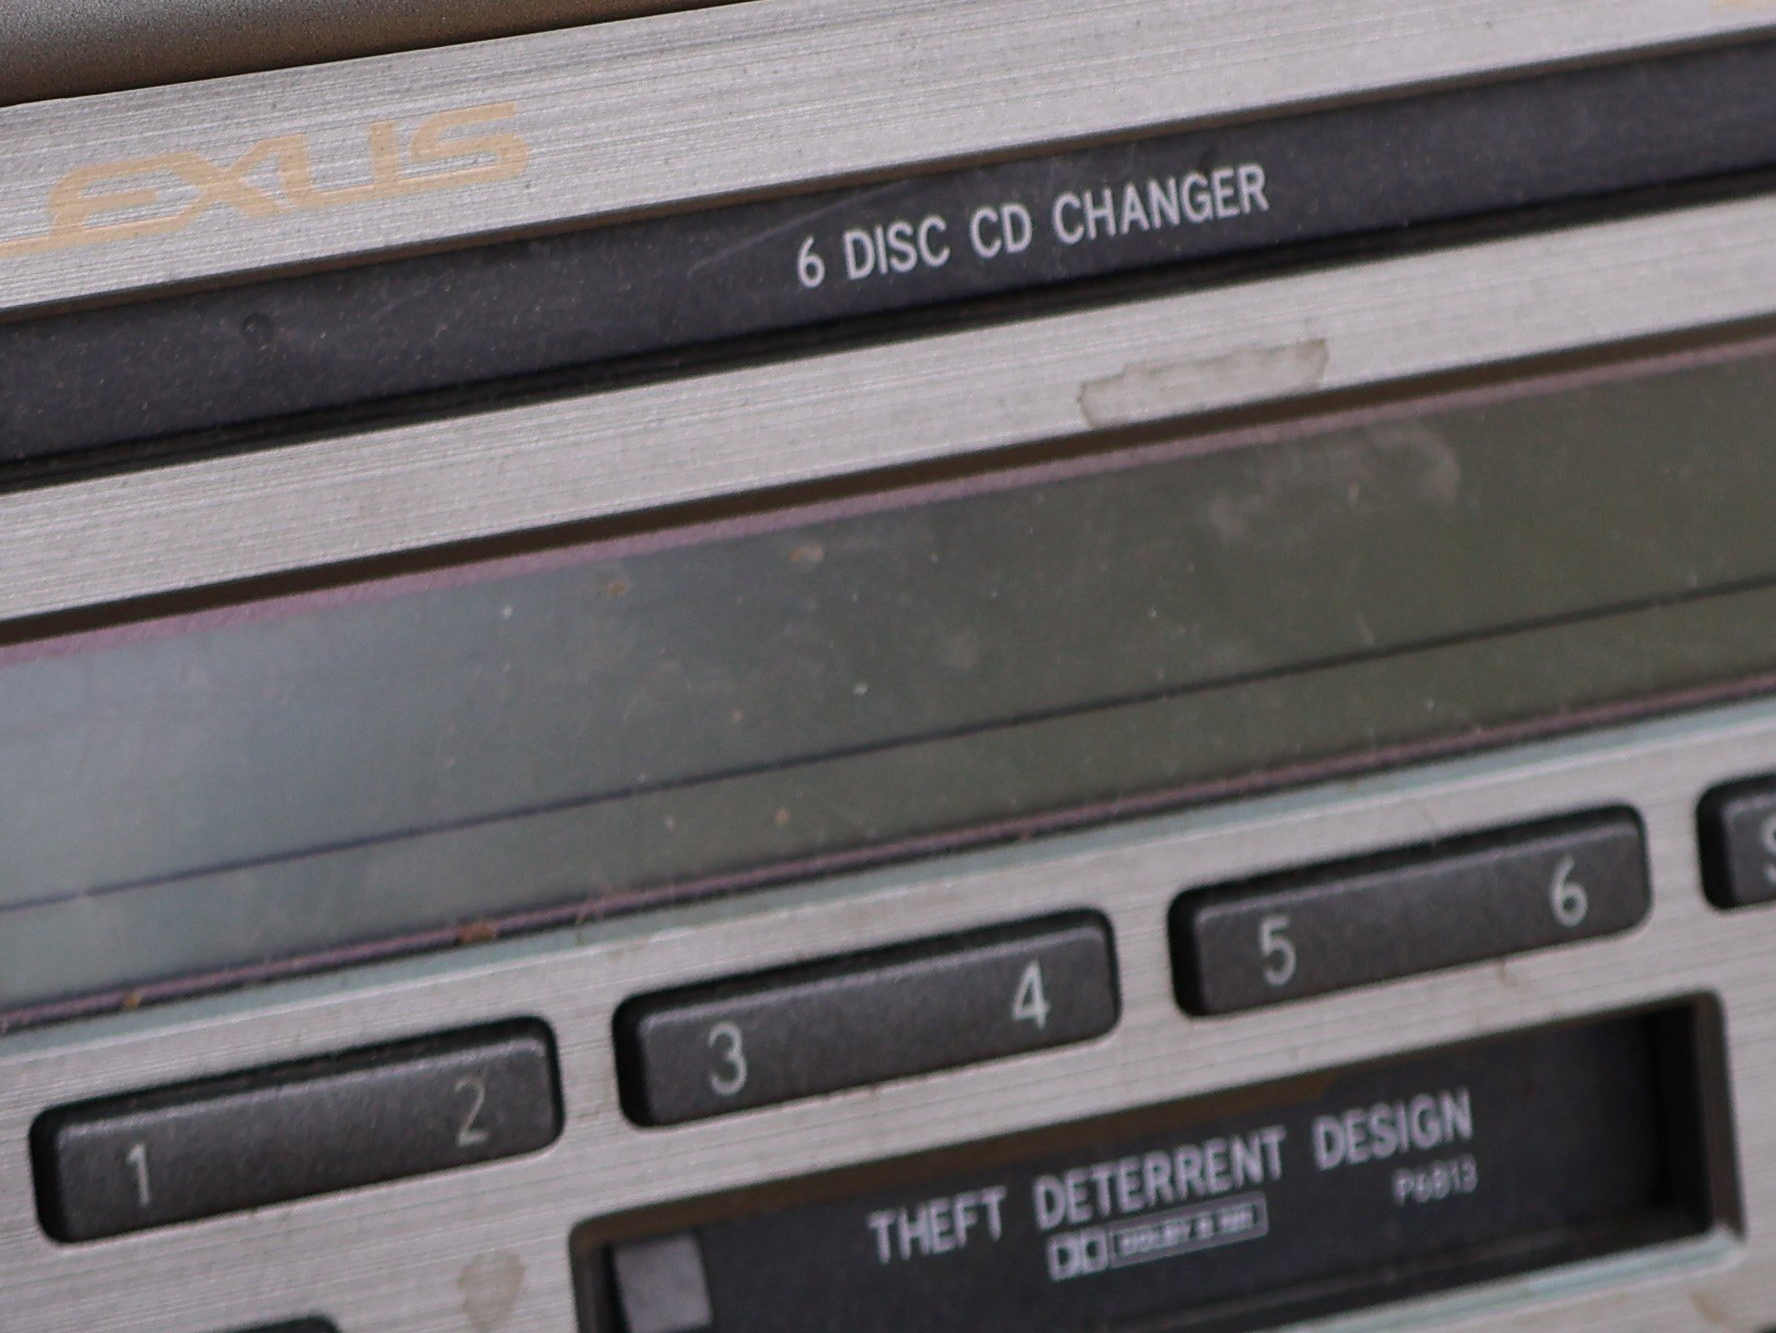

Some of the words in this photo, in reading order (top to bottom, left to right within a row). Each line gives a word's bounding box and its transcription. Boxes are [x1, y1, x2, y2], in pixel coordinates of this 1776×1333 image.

[796, 235, 826, 290] 6
[843, 216, 952, 279] DISC
[969, 199, 1034, 259] CD
[1052, 162, 1270, 246] CHANGER
[1255, 912, 1299, 989] 5
[1547, 854, 1589, 928] 6
[706, 1019, 749, 1098] 3
[1010, 960, 1051, 1032] 4
[125, 1142, 153, 1208] 1
[454, 1073, 491, 1149] 2
[867, 1184, 1007, 1265] THEFT
[1032, 1124, 1289, 1231] DETERRENT
[1311, 1085, 1476, 1171] DESIGN
